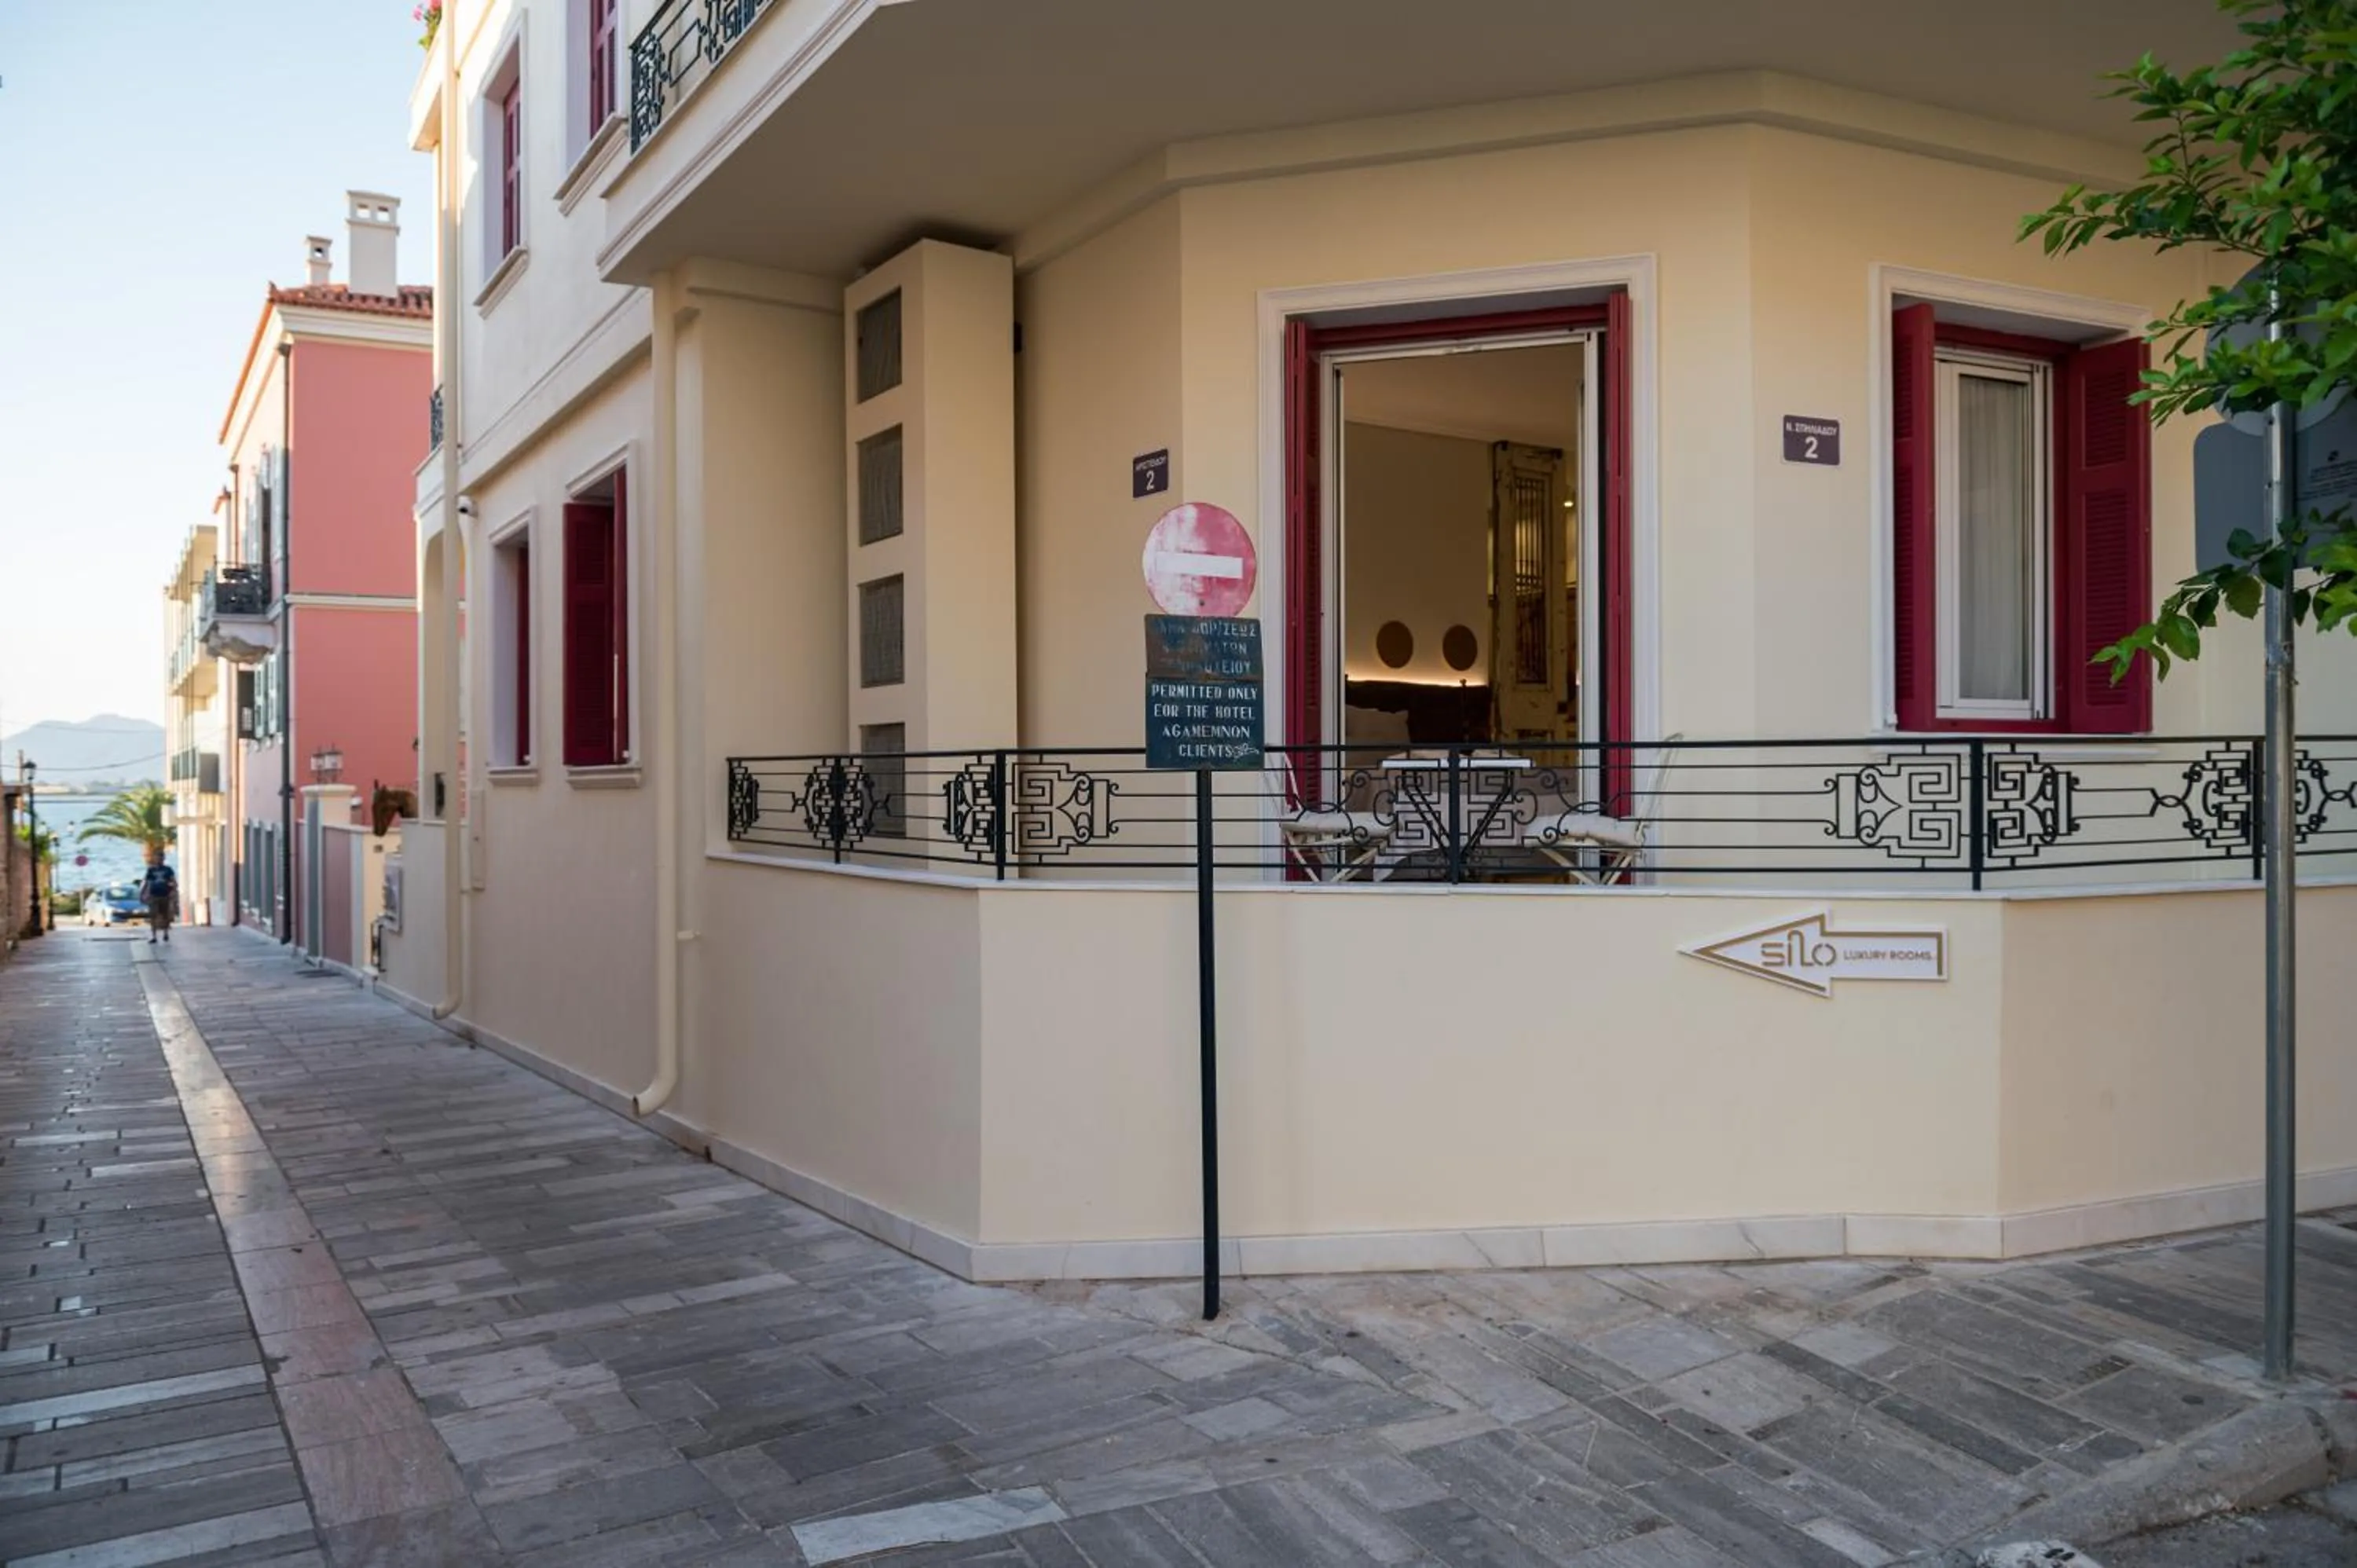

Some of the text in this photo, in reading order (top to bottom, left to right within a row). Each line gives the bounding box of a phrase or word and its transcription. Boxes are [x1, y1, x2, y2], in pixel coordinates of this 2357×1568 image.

[1805, 436, 1818, 458] 2
[1146, 471, 1154, 490] 2
[1151, 684, 1257, 700] PERMITTED ONLY
[1186, 705, 1209, 718] THE
[1215, 705, 1255, 720] HOTEL
[1163, 724, 1250, 738] AGAMEMNON
[1179, 744, 1233, 758] CLIENTS
[1843, 950, 1886, 960] LUXURY
[1890, 951, 1932, 961] ROOMS
